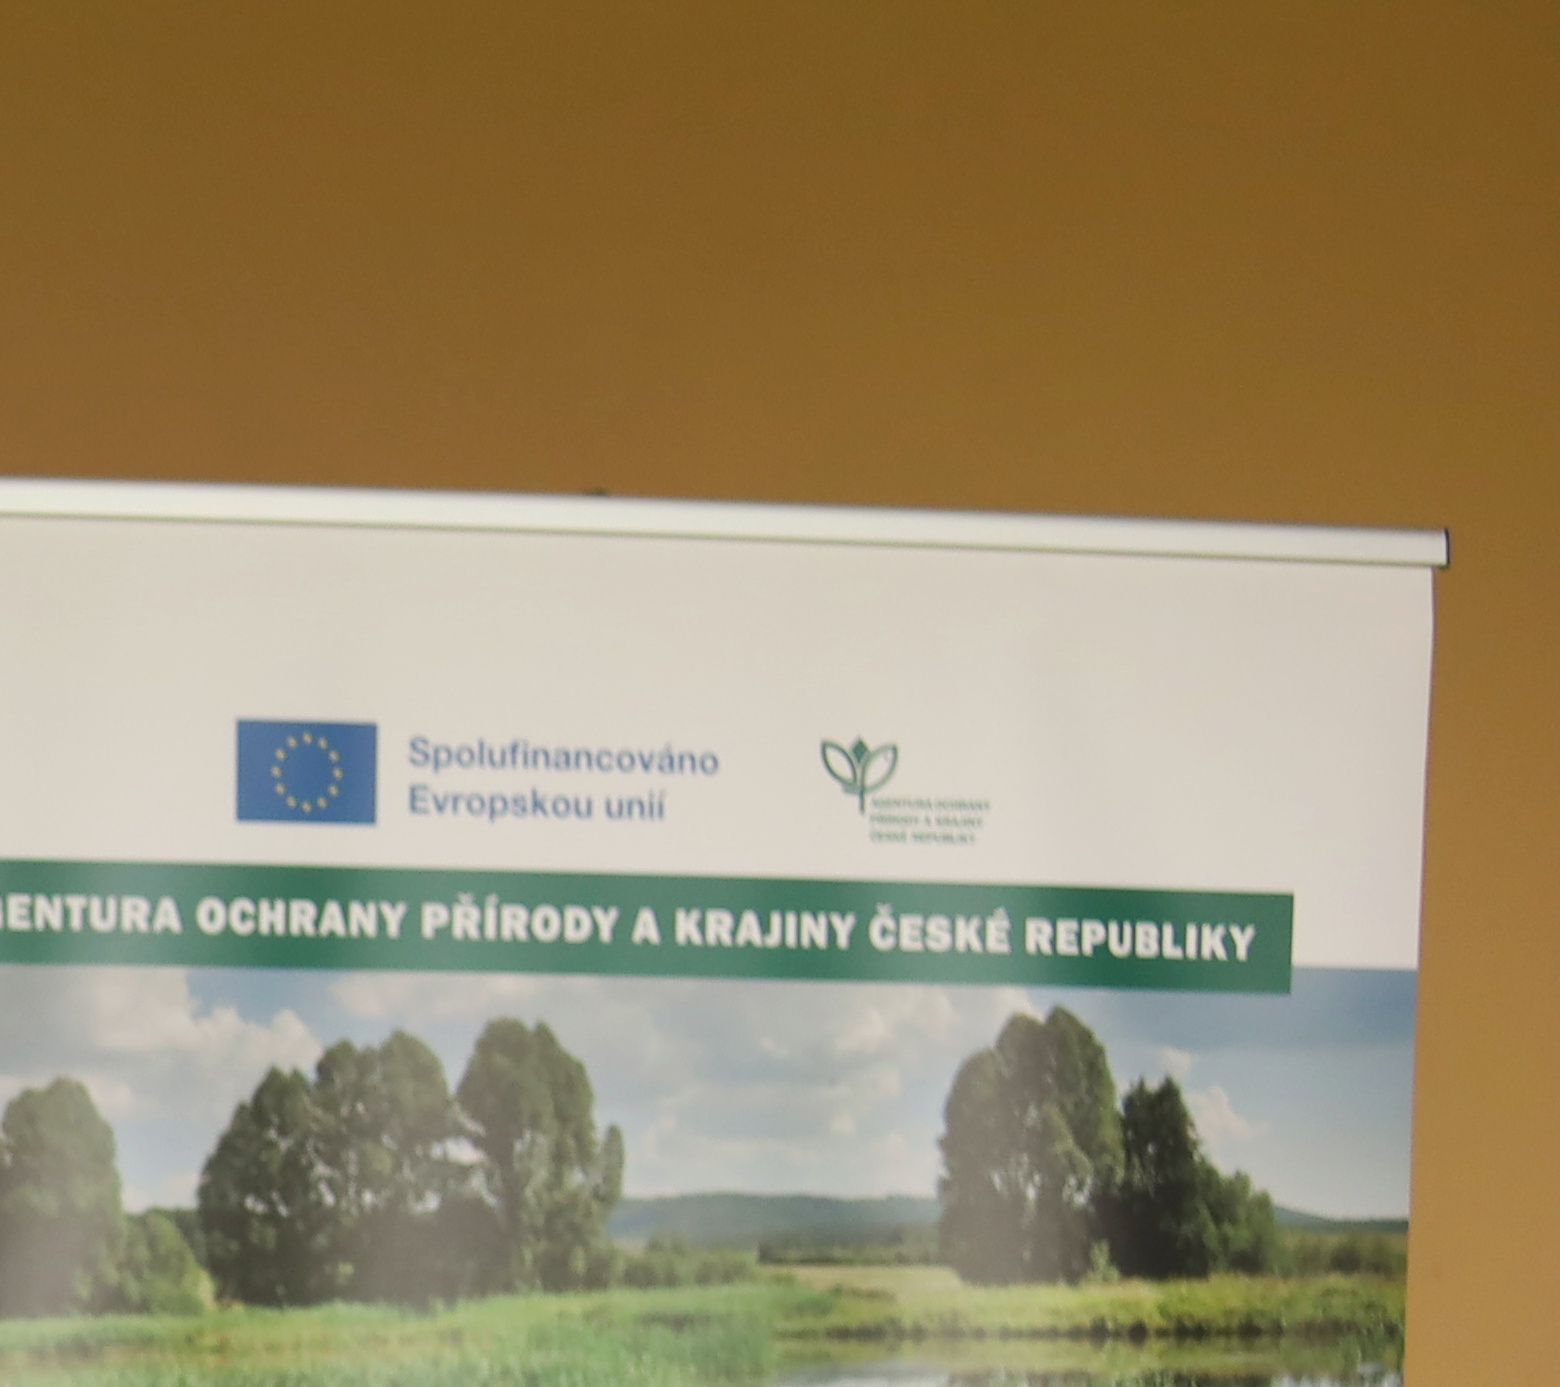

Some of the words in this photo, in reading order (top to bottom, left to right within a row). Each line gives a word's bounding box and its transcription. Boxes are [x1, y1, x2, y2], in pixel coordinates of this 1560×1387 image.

[407, 736, 719, 777] Spolufinancováno
[407, 784, 594, 824] Evropskou
[603, 787, 668, 822] unií
[195, 897, 407, 939] OCHRANY
[421, 892, 619, 944] PŘÍRODY
[631, 906, 661, 945] A
[675, 906, 857, 950] KRAJINY
[868, 903, 1012, 955] ČESKÉ
[1025, 917, 1257, 962] REPUBLIKY
